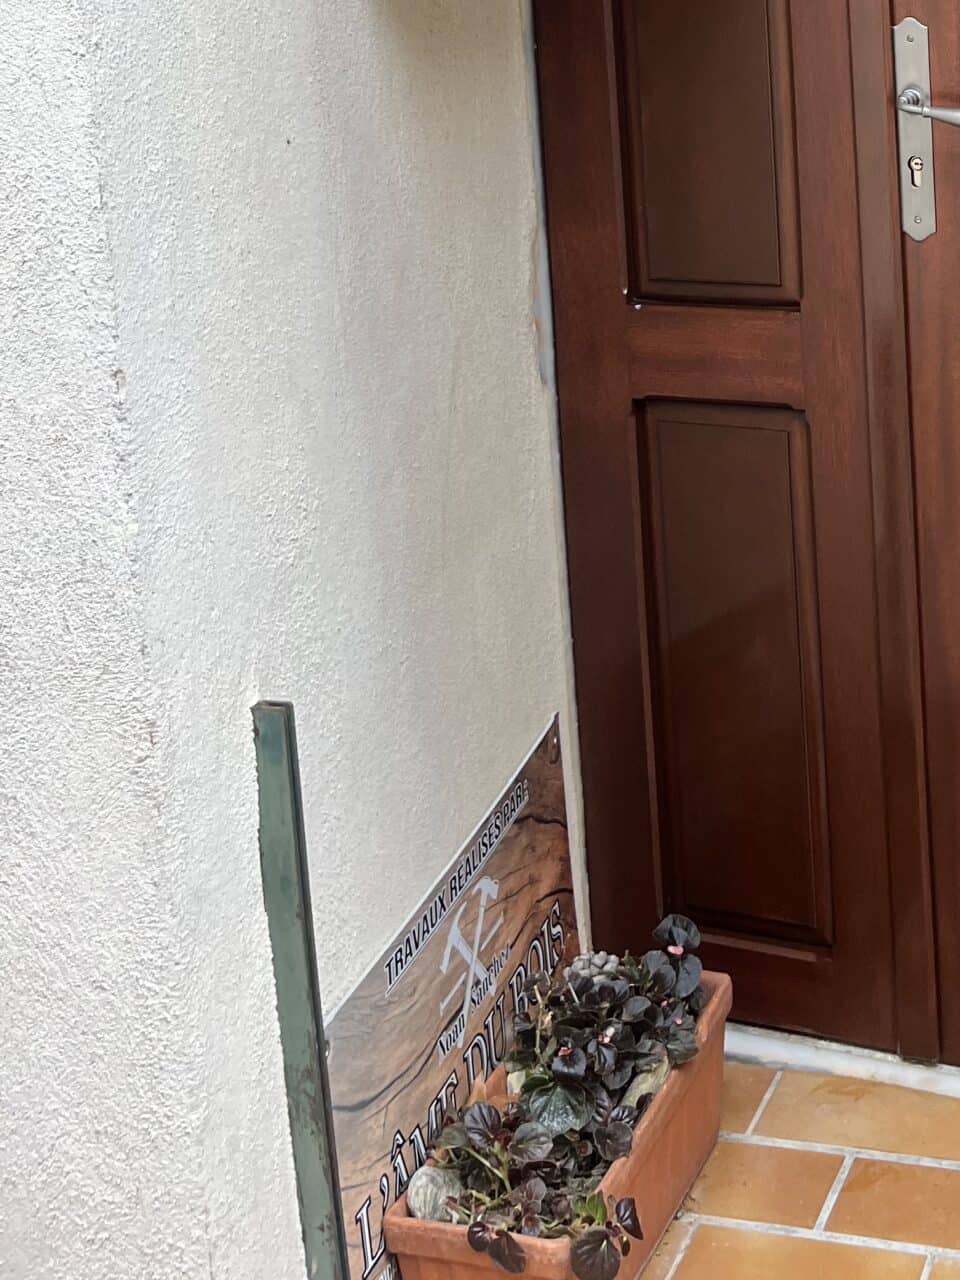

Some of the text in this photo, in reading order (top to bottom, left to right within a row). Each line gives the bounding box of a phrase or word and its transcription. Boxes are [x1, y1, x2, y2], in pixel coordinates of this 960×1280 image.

[384, 887, 447, 987] TRAVAUX
[463, 991, 505, 1096] DU
[509, 899, 564, 1015] BOIS
